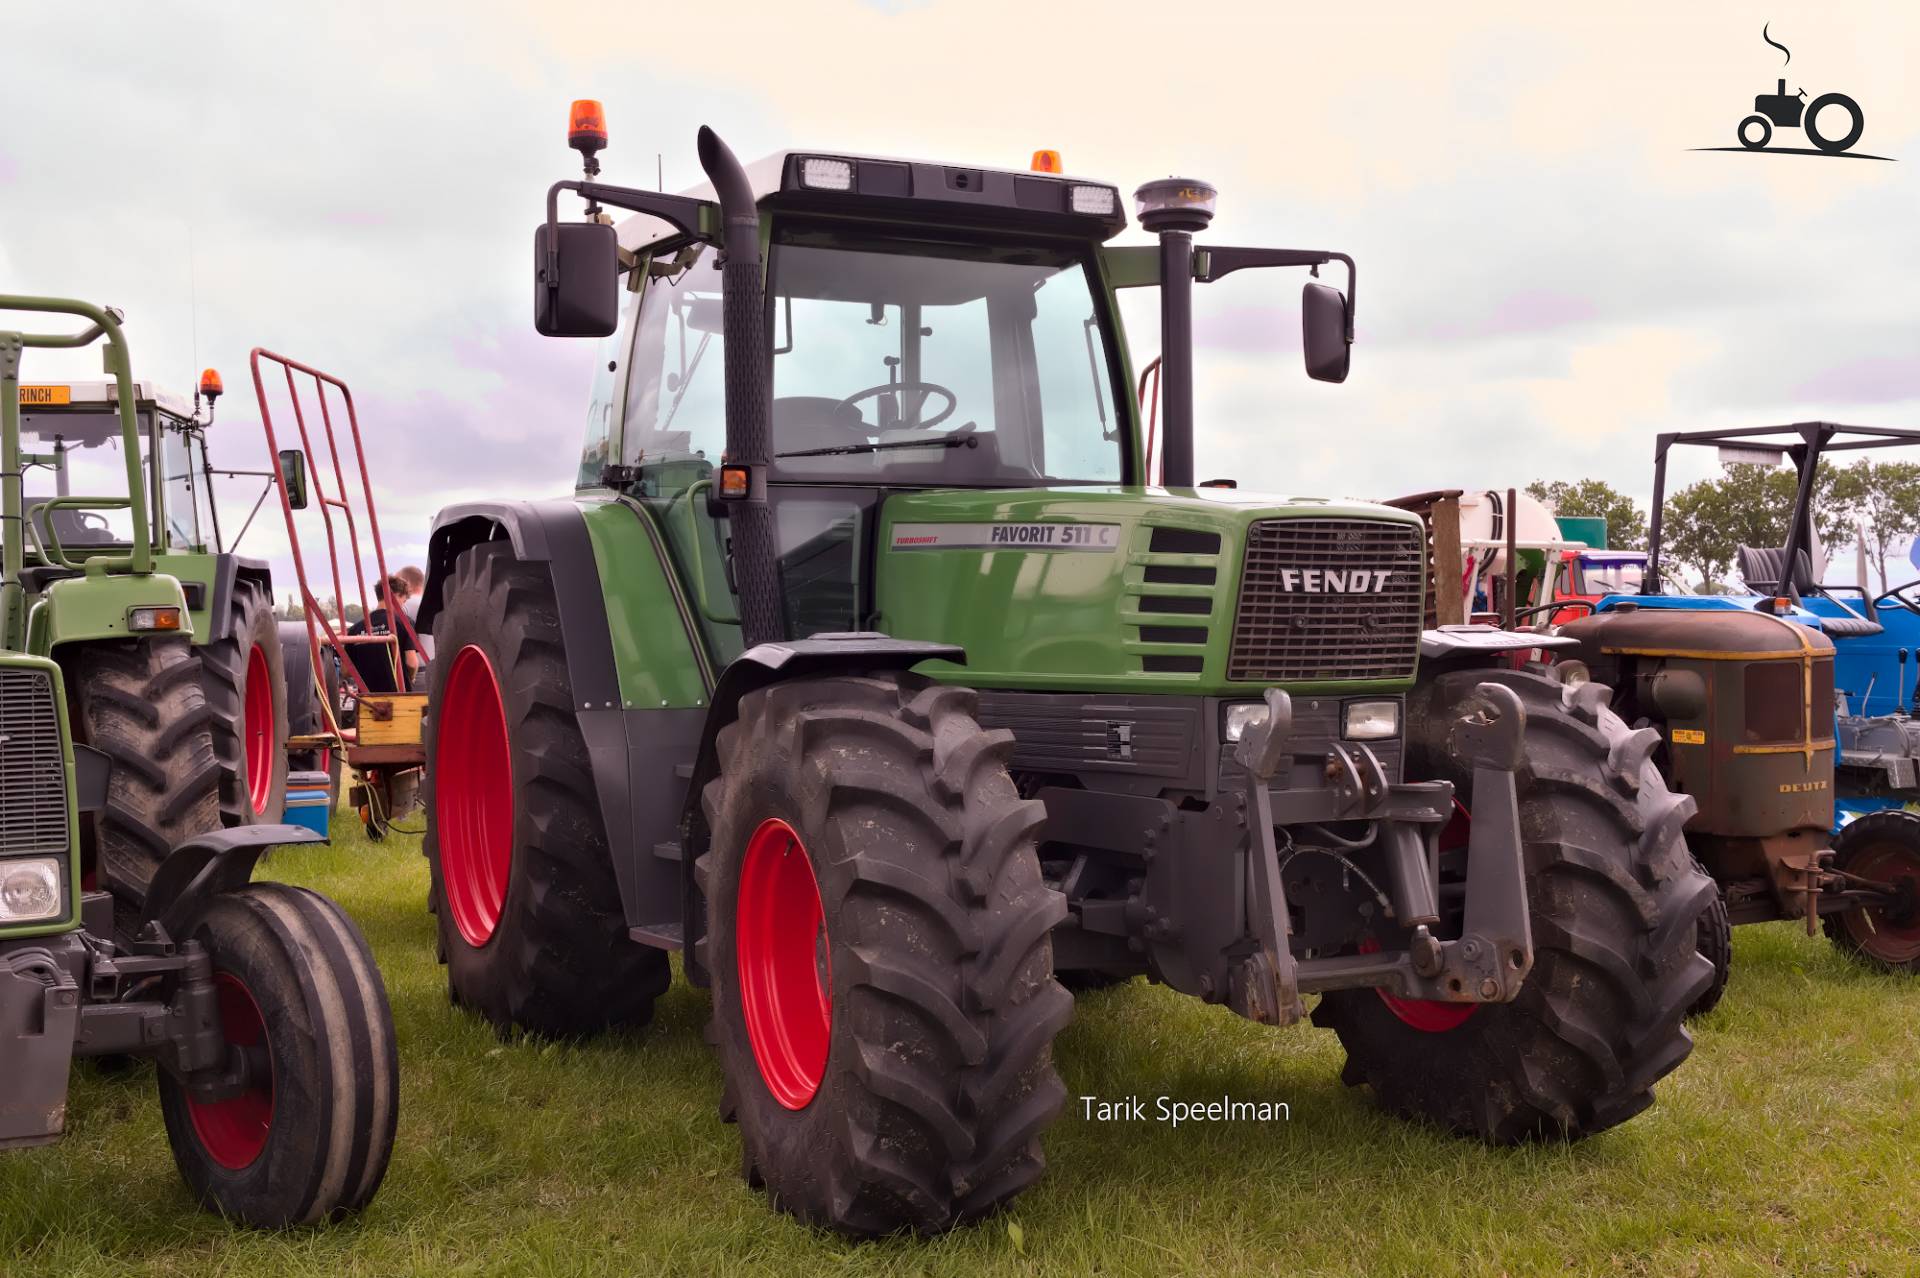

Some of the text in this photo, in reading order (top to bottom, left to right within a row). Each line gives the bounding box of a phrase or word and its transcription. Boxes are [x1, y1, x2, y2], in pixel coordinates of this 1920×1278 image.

[992, 525, 1056, 543] FAVORIT
[1060, 526, 1092, 544] 511
[1098, 527, 1110, 544] C
[1280, 568, 1392, 593] FENDT
[1779, 780, 1828, 793] DEUTZ
